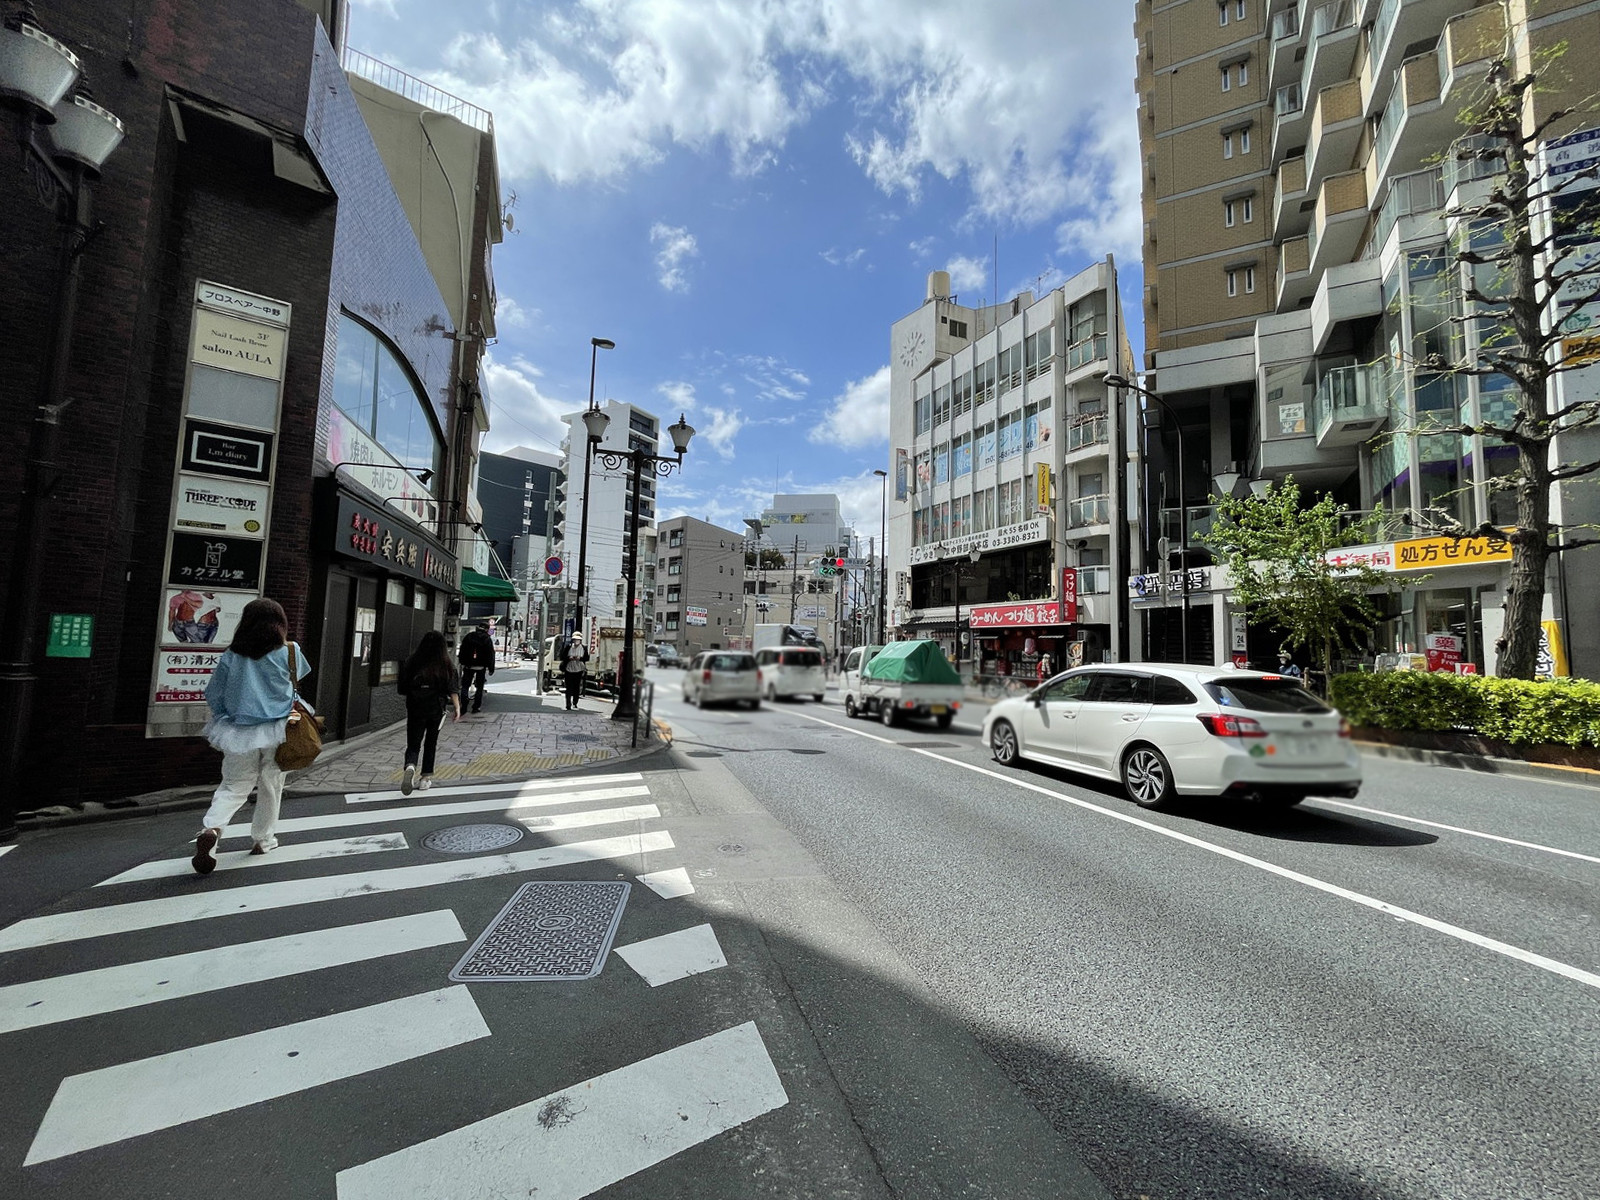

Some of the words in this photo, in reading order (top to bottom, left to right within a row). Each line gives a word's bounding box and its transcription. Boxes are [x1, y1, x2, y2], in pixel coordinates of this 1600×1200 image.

[202, 344, 233, 356] salon
[235, 350, 273, 365] AULA
[225, 450, 248, 461] diary
[181, 566, 244, 579] カクテル堂
[1065, 573, 1075, 603] つけ麺
[970, 610, 1003, 626] らーめん
[1004, 606, 1035, 623] つけ麺
[1036, 608, 1058, 623] 餃子
[1443, 652, 1459, 660] Tax
